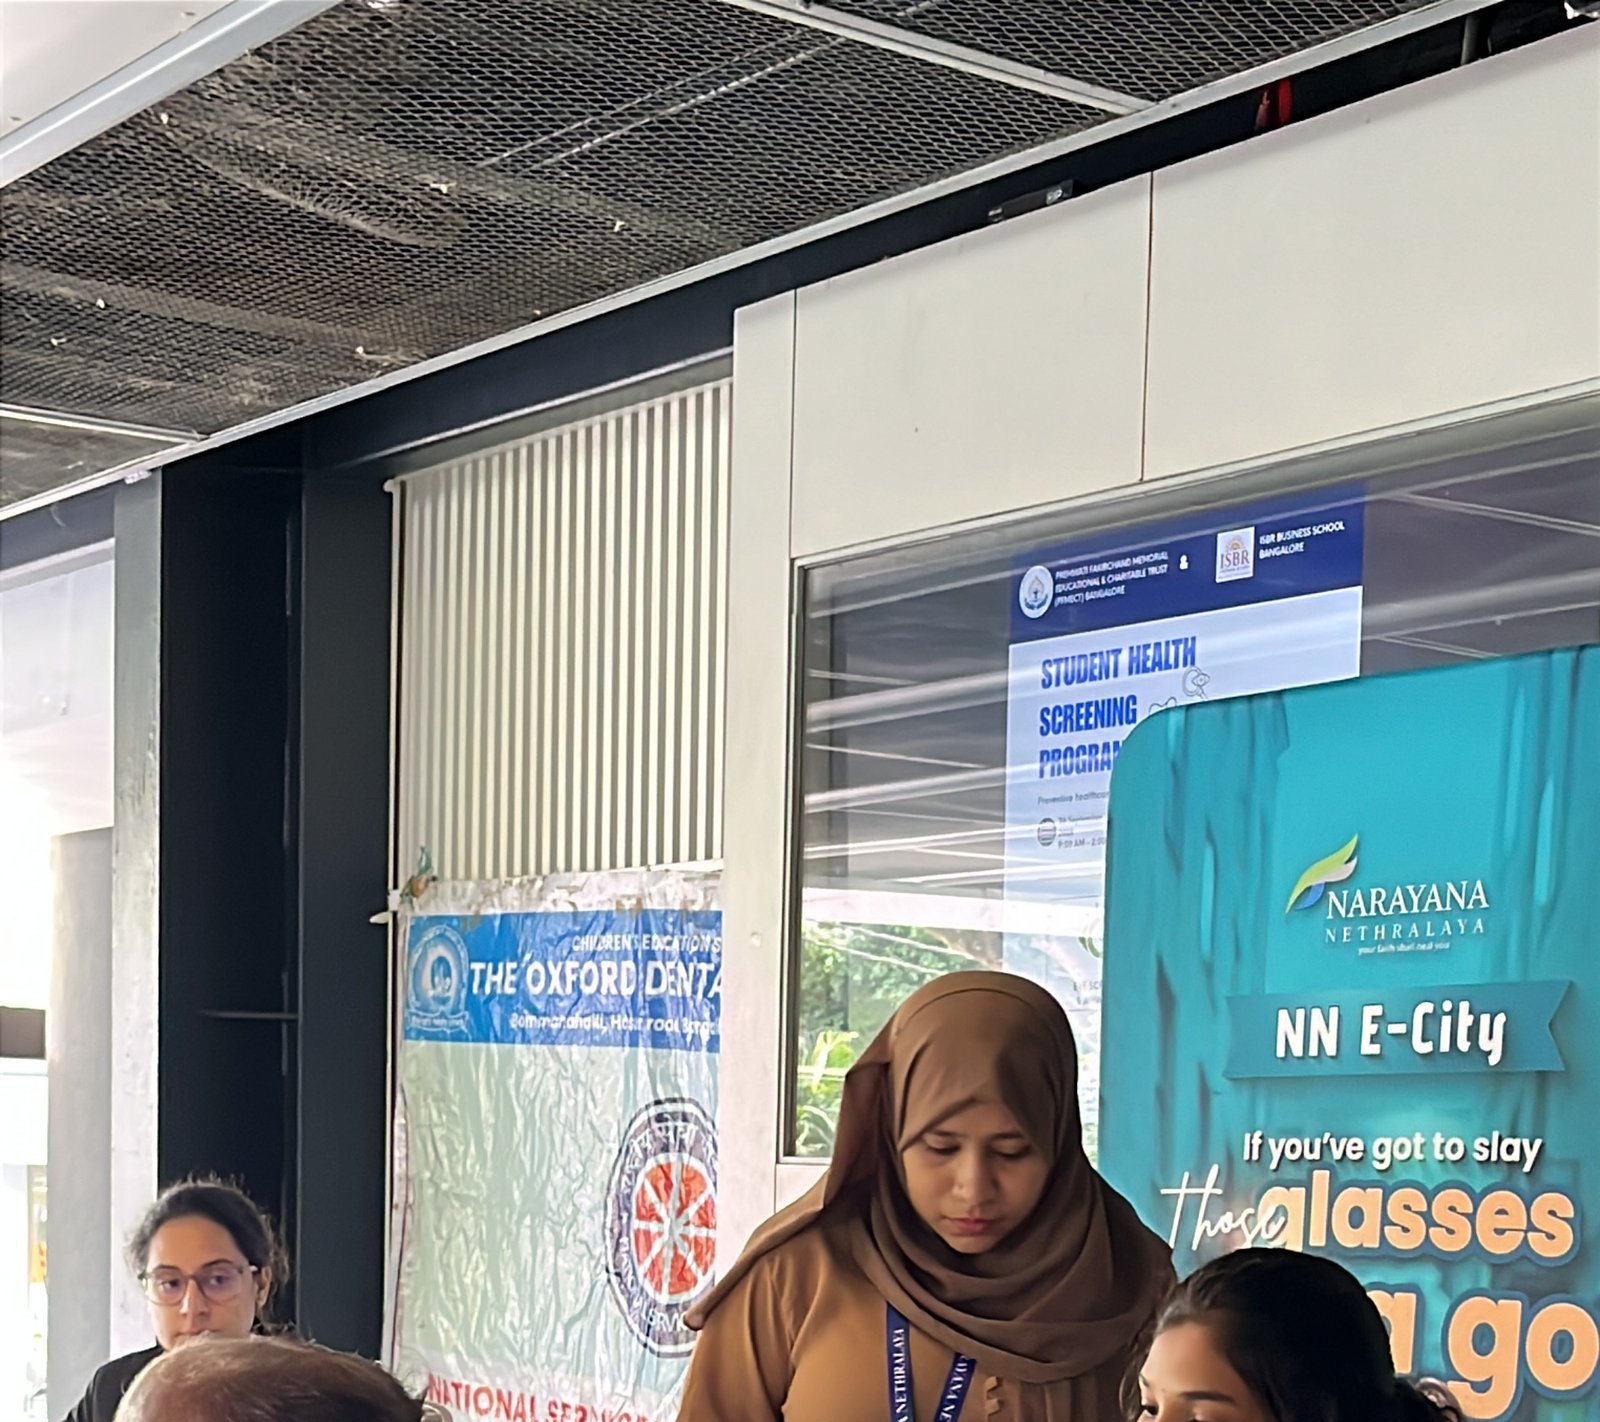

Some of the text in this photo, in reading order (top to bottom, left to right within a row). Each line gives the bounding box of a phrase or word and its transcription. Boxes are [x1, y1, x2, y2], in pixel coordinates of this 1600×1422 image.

[1259, 542, 1304, 559] BANGALORE
[1260, 520, 1344, 544] ISBR BUSINESS SCHOOL
[1147, 564, 1168, 576] TRUST
[1180, 554, 1188, 570] &
[1220, 549, 1250, 568] ISBR
[1041, 636, 1196, 690] STUDENT HEALTH
[1040, 694, 1137, 736] SCREENING
[1326, 879, 1490, 920] NARAYANA
[1325, 918, 1484, 943] NETHRALAYA
[471, 962, 518, 995] THE
[1276, 1000, 1506, 1066] NN E-City
[1243, 1131, 1543, 1172] If you've got to slay
[1257, 1170, 1576, 1258] glasses
[892, 1328, 908, 1414] NETHRALAYA
[1447, 1296, 1600, 1420] go
